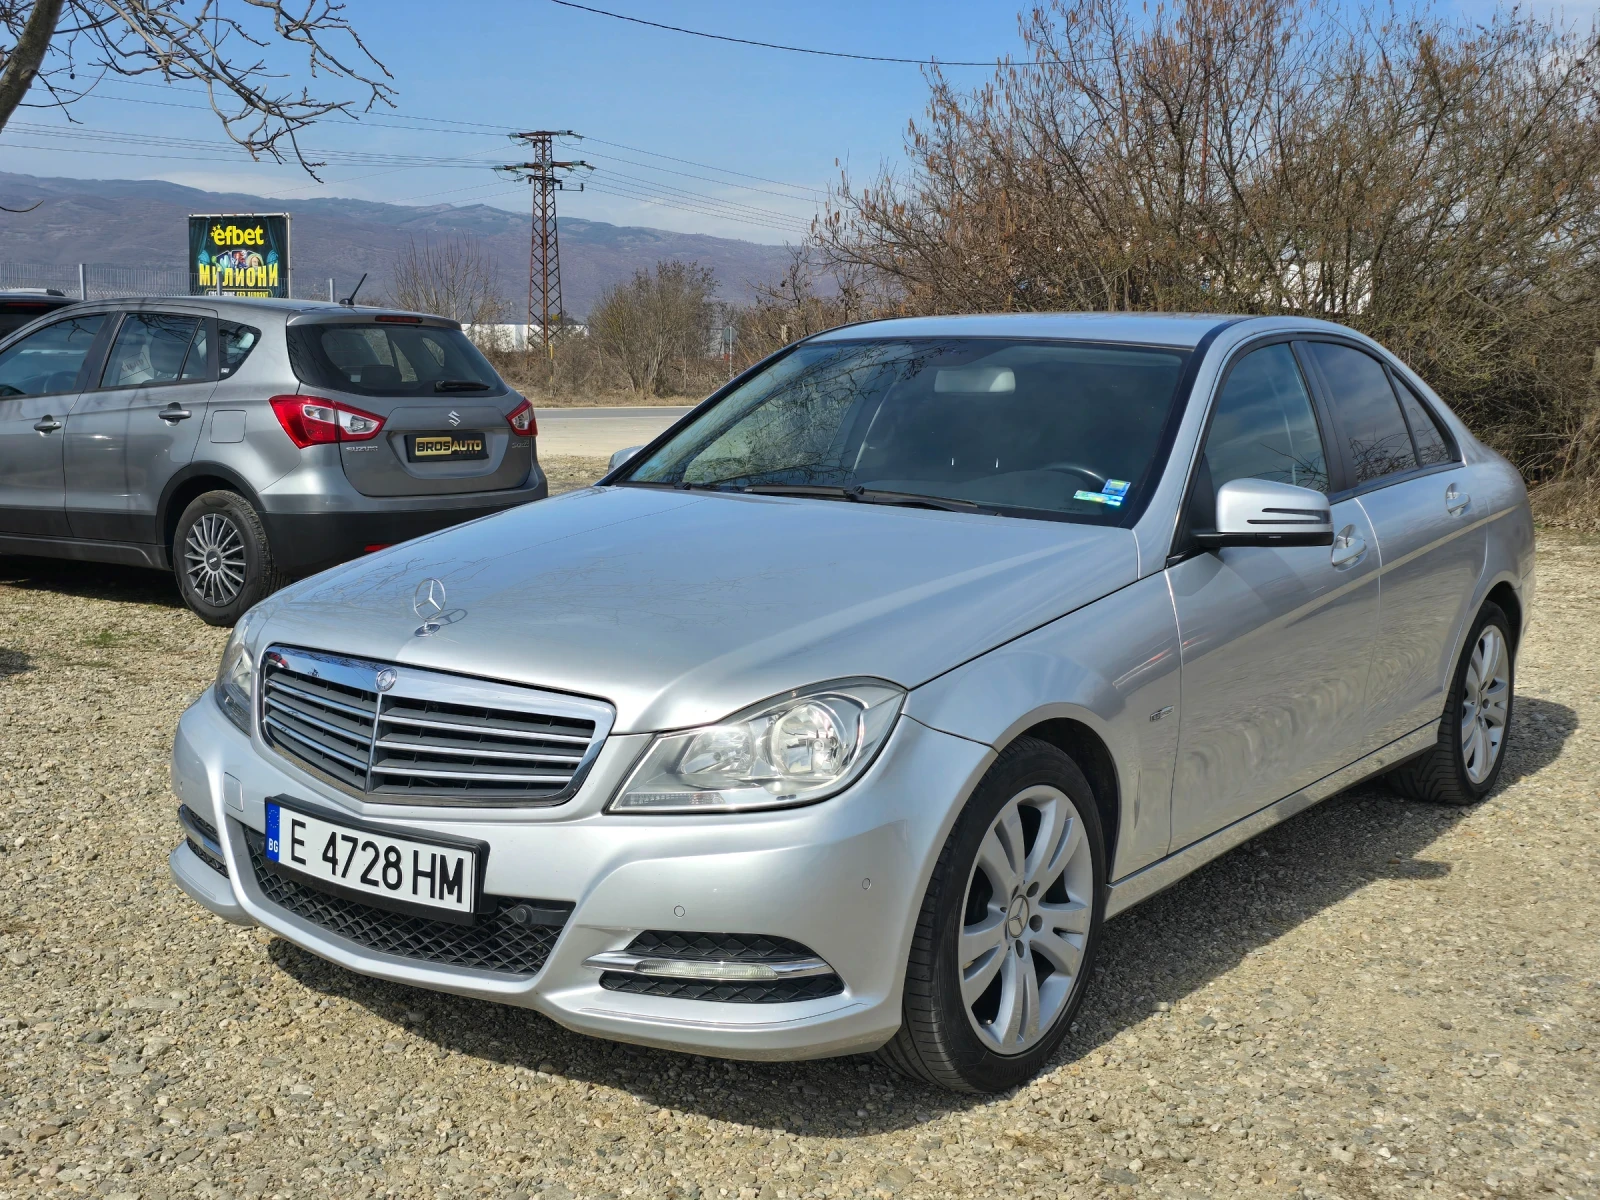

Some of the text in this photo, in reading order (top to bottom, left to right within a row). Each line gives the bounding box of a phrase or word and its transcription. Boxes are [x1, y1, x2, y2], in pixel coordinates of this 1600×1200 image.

[213, 225, 264, 245] efbet
[268, 838, 279, 853] BG
[291, 818, 464, 904] E 4728 HM
